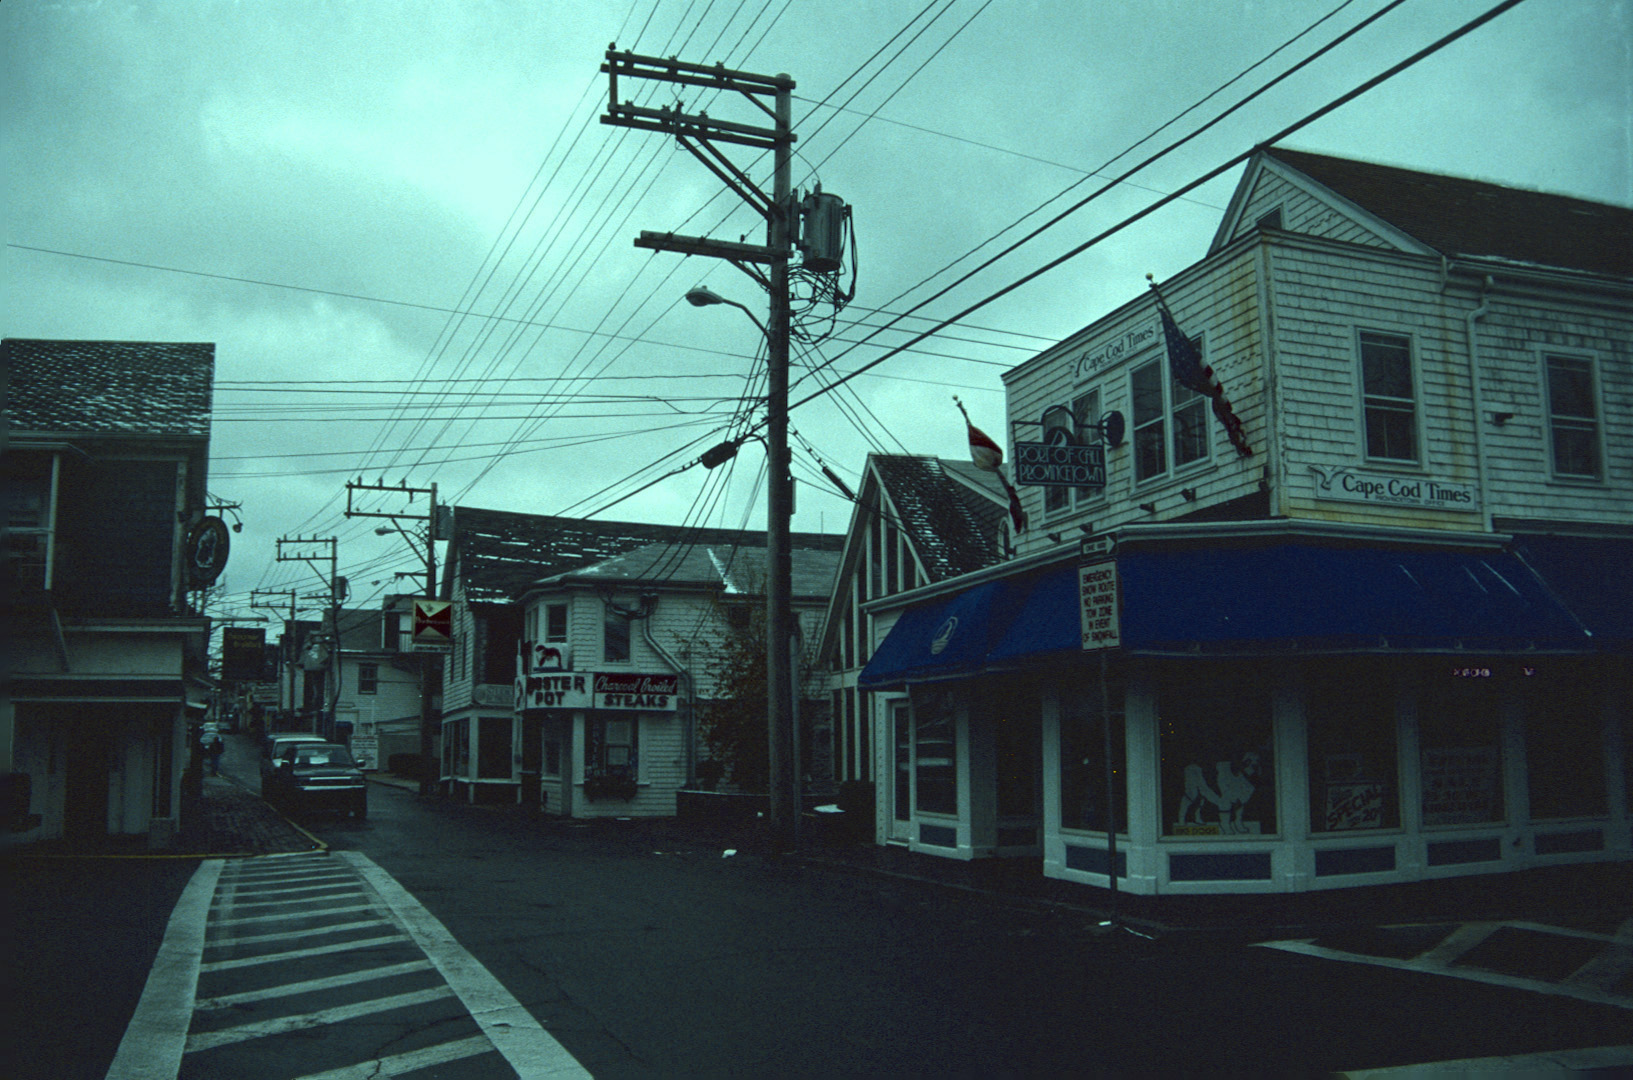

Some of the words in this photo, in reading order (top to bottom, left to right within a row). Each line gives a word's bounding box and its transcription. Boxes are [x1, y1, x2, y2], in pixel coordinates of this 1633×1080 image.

[1083, 354, 1105, 372] Cape
[1105, 339, 1125, 360] Cod
[1127, 326, 1155, 349] Times
[1019, 464, 1105, 483] PROVINCETOWN
[1342, 474, 1384, 499] Cape
[1388, 479, 1421, 499] Cod
[1425, 482, 1471, 504] Times
[1082, 570, 1113, 585] EMERGENCY
[1082, 585, 1097, 596] SNOW
[1098, 580, 1115, 593] ROUTE
[1084, 597, 1092, 608] NO
[1092, 592, 1114, 605] PARKING
[1086, 608, 1097, 619] TOW
[1098, 605, 1112, 617] ZONE
[1088, 620, 1094, 630] IN
[1095, 617, 1110, 629] EVENT
[1083, 632, 1090, 643] OF
[1091, 630, 1118, 643] SNOWFALL
[536, 691, 565, 706] POT
[604, 693, 669, 708] STEAKS
